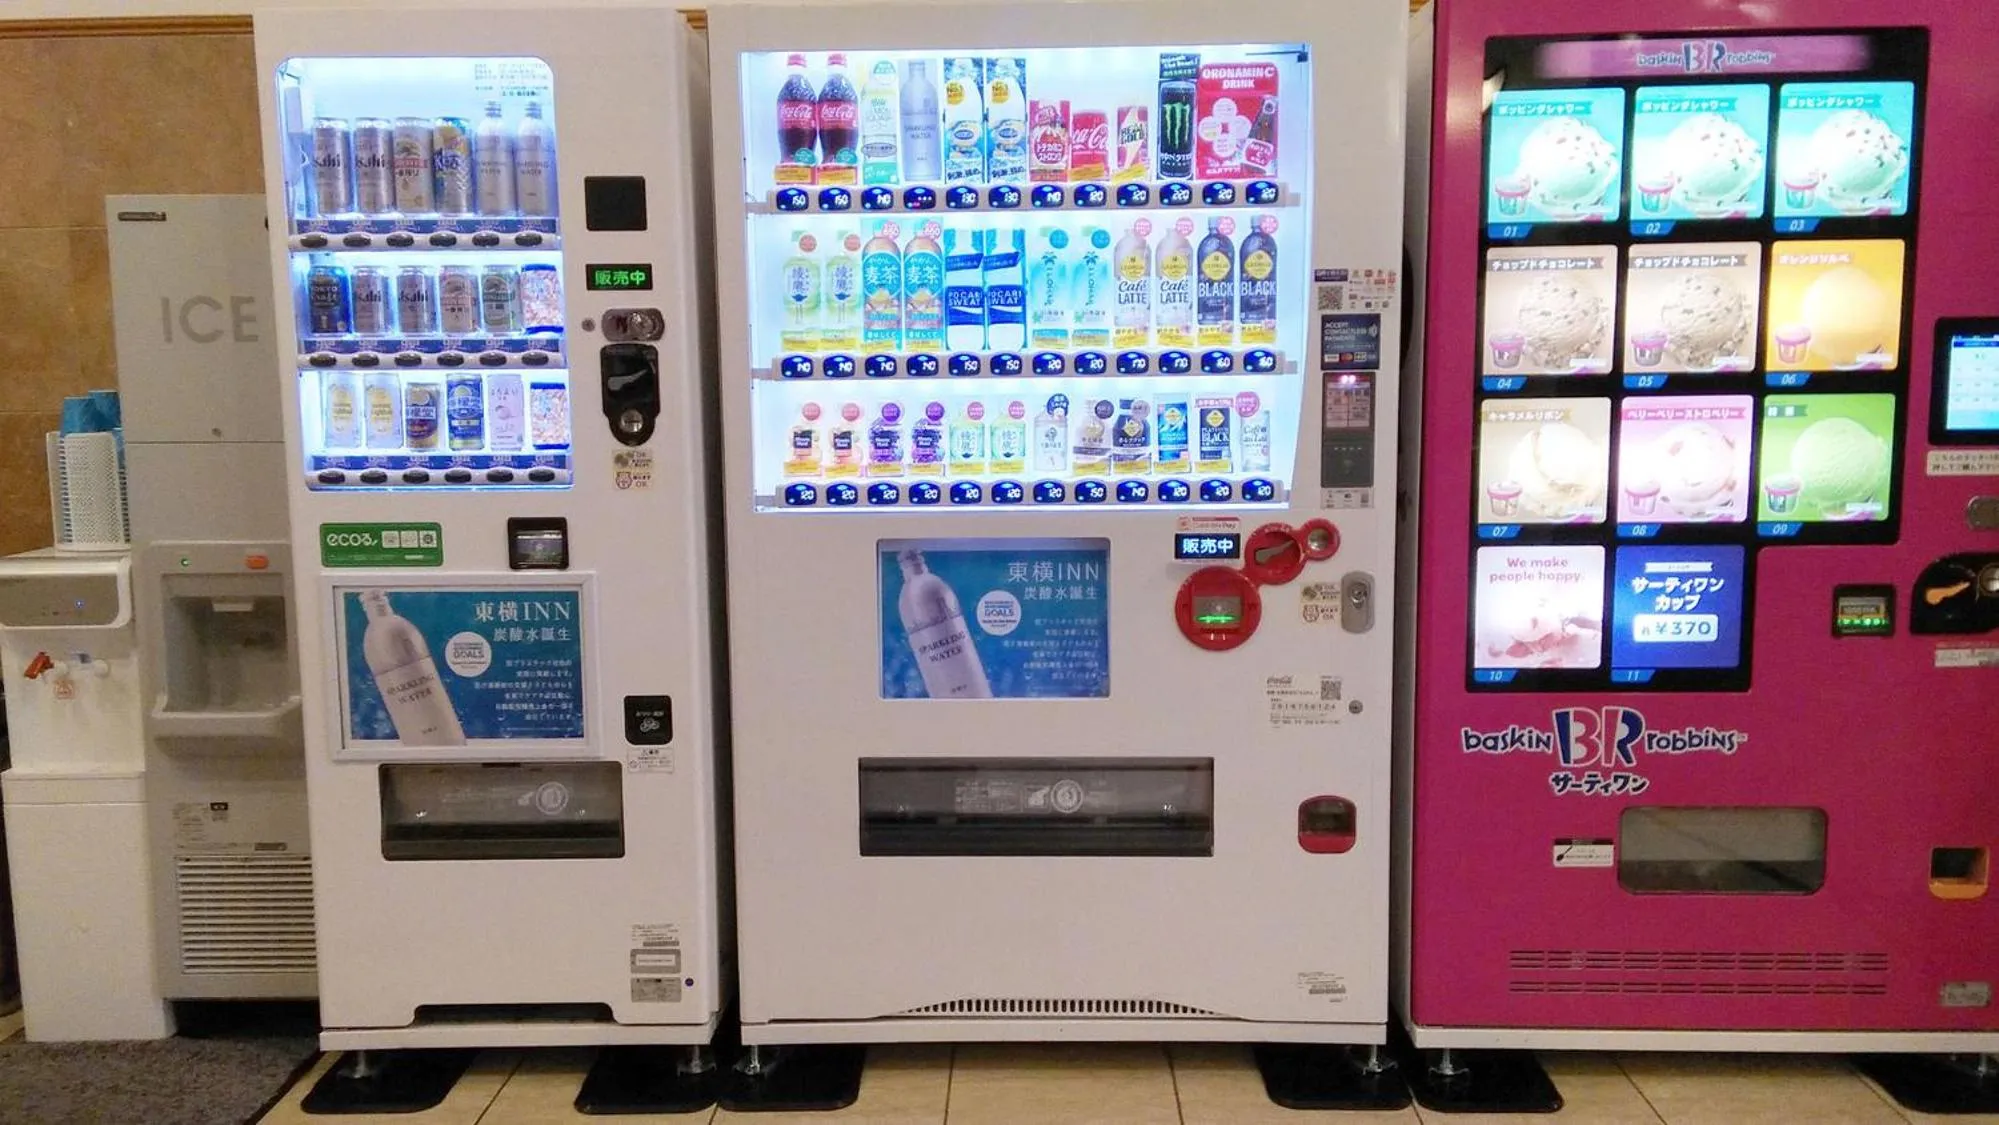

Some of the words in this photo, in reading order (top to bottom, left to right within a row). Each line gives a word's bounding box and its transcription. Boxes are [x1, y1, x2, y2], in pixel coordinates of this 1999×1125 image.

[1682, 41, 1727, 73] BR
[1202, 68, 1262, 79] ORONAMIN
[1263, 66, 1275, 78] C
[1222, 79, 1255, 89] DRINK
[792, 194, 806, 206] 150
[834, 194, 849, 206] 150
[1172, 190, 1190, 201] 220
[1503, 225, 1517, 237] 01
[1646, 222, 1661, 234] 02
[1789, 219, 1804, 231] 03
[1492, 258, 1594, 270] チョップドチョコレート
[1634, 255, 1738, 267] チョップドチョコレート
[595, 270, 646, 286] 販売中
[865, 266, 899, 285] 麦茶
[907, 266, 940, 285] 麦茶
[1118, 279, 1147, 293] Café
[1160, 279, 1188, 293] Café
[1199, 283, 1233, 297] BLACK
[1241, 281, 1276, 296] BLACK
[1117, 293, 1147, 305] LATTE
[1159, 292, 1189, 304] LATTE
[159, 296, 259, 343] ICE
[964, 359, 978, 371] 150
[1005, 359, 1019, 371] 150
[1497, 377, 1511, 389] 04
[1637, 375, 1652, 387] 05
[1780, 374, 1795, 386] 06
[1627, 408, 1739, 420] ベリーベリーストロベリー
[1202, 432, 1229, 442] BLACK
[1493, 526, 1508, 537] 07
[1632, 525, 1647, 536] 08
[1772, 523, 1788, 535] 09
[1183, 538, 1234, 554] 販売中
[1506, 557, 1526, 568] We
[1530, 556, 1569, 567] make
[1008, 562, 1099, 582] 東横INN
[1489, 571, 1535, 584] people
[1631, 577, 1725, 594] サーティワン
[1023, 587, 1099, 600] 炭酸水誕生
[1654, 594, 1701, 612] カップ
[473, 601, 572, 622] 東横INN
[984, 609, 1014, 617] GOALS
[1656, 621, 1711, 635] ¥370
[493, 628, 572, 642] 炭酸水誕生
[453, 650, 485, 659] GOALS
[930, 645, 963, 663] WATER
[1489, 671, 1503, 681] 10
[1626, 671, 1639, 681] 11
[1462, 726, 1553, 754] baskin
[1552, 706, 1645, 767] BR
[1645, 728, 1738, 753] robbins
[1550, 772, 1650, 795] サーティワン
